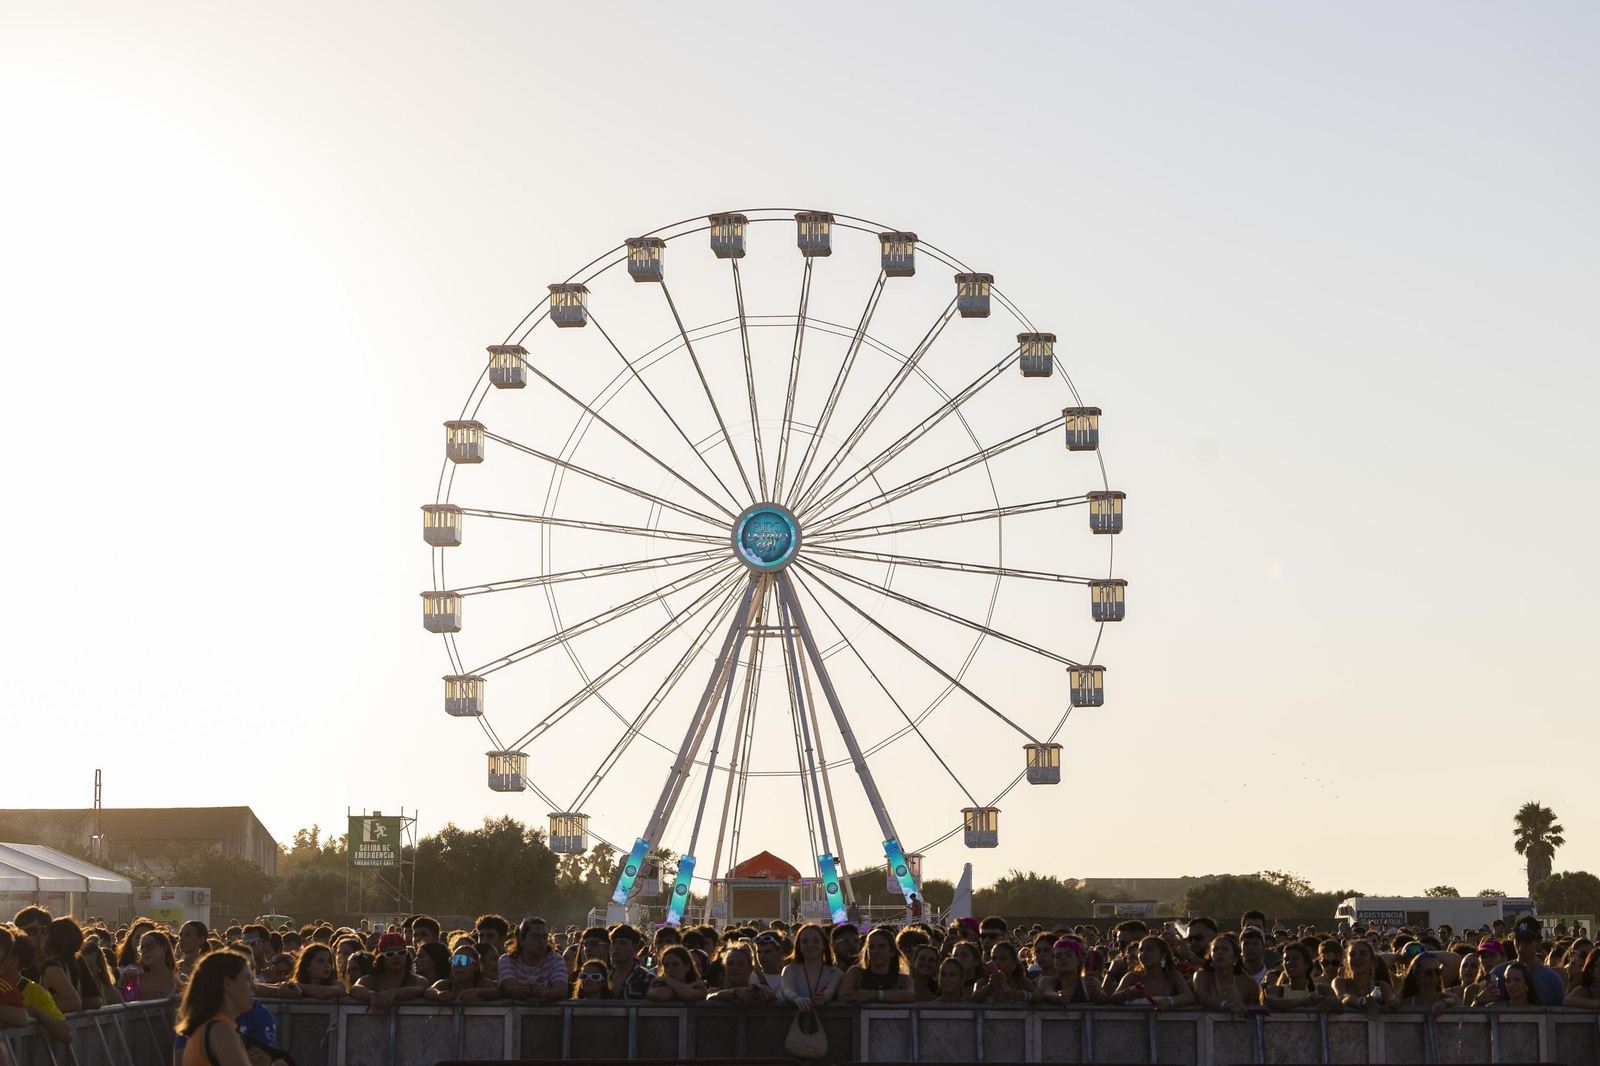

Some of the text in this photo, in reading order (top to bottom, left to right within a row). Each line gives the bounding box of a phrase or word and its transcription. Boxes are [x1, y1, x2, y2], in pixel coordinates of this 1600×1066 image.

[753, 521, 782, 532] PURO
[747, 532, 789, 541] LATINO
[359, 844, 390, 852] SALIDA DE
[354, 851, 395, 859] EMERGENCIA
[1359, 911, 1403, 919] ASISTENCIA
